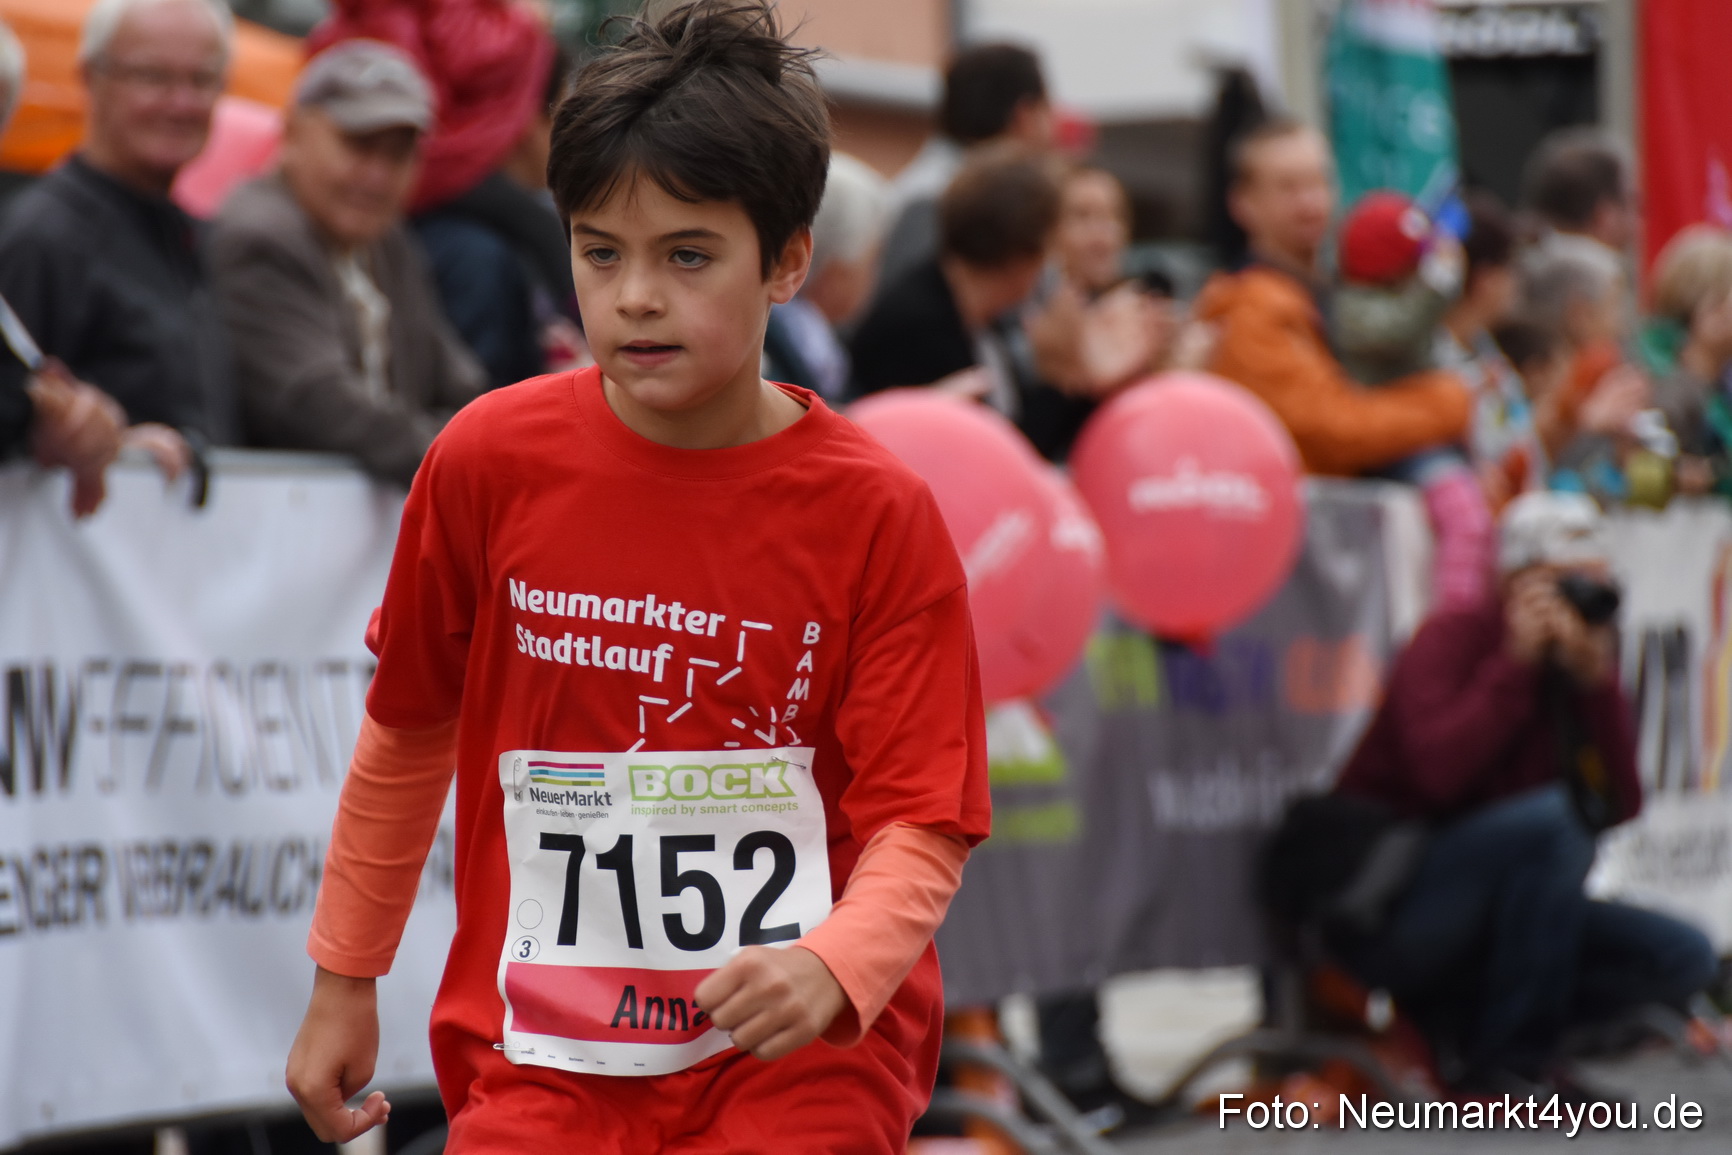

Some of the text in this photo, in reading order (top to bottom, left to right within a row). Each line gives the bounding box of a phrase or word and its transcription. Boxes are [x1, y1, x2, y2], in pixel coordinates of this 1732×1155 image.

[509, 578, 726, 637] Neumarkter
[515, 623, 674, 682] Stadtlauf
[529, 787, 613, 806] NeuerMarkt
[628, 762, 797, 801] BOCK
[631, 801, 799, 816] inspired by smart concepts
[539, 830, 802, 952] 7152
[519, 939, 532, 958] 3
